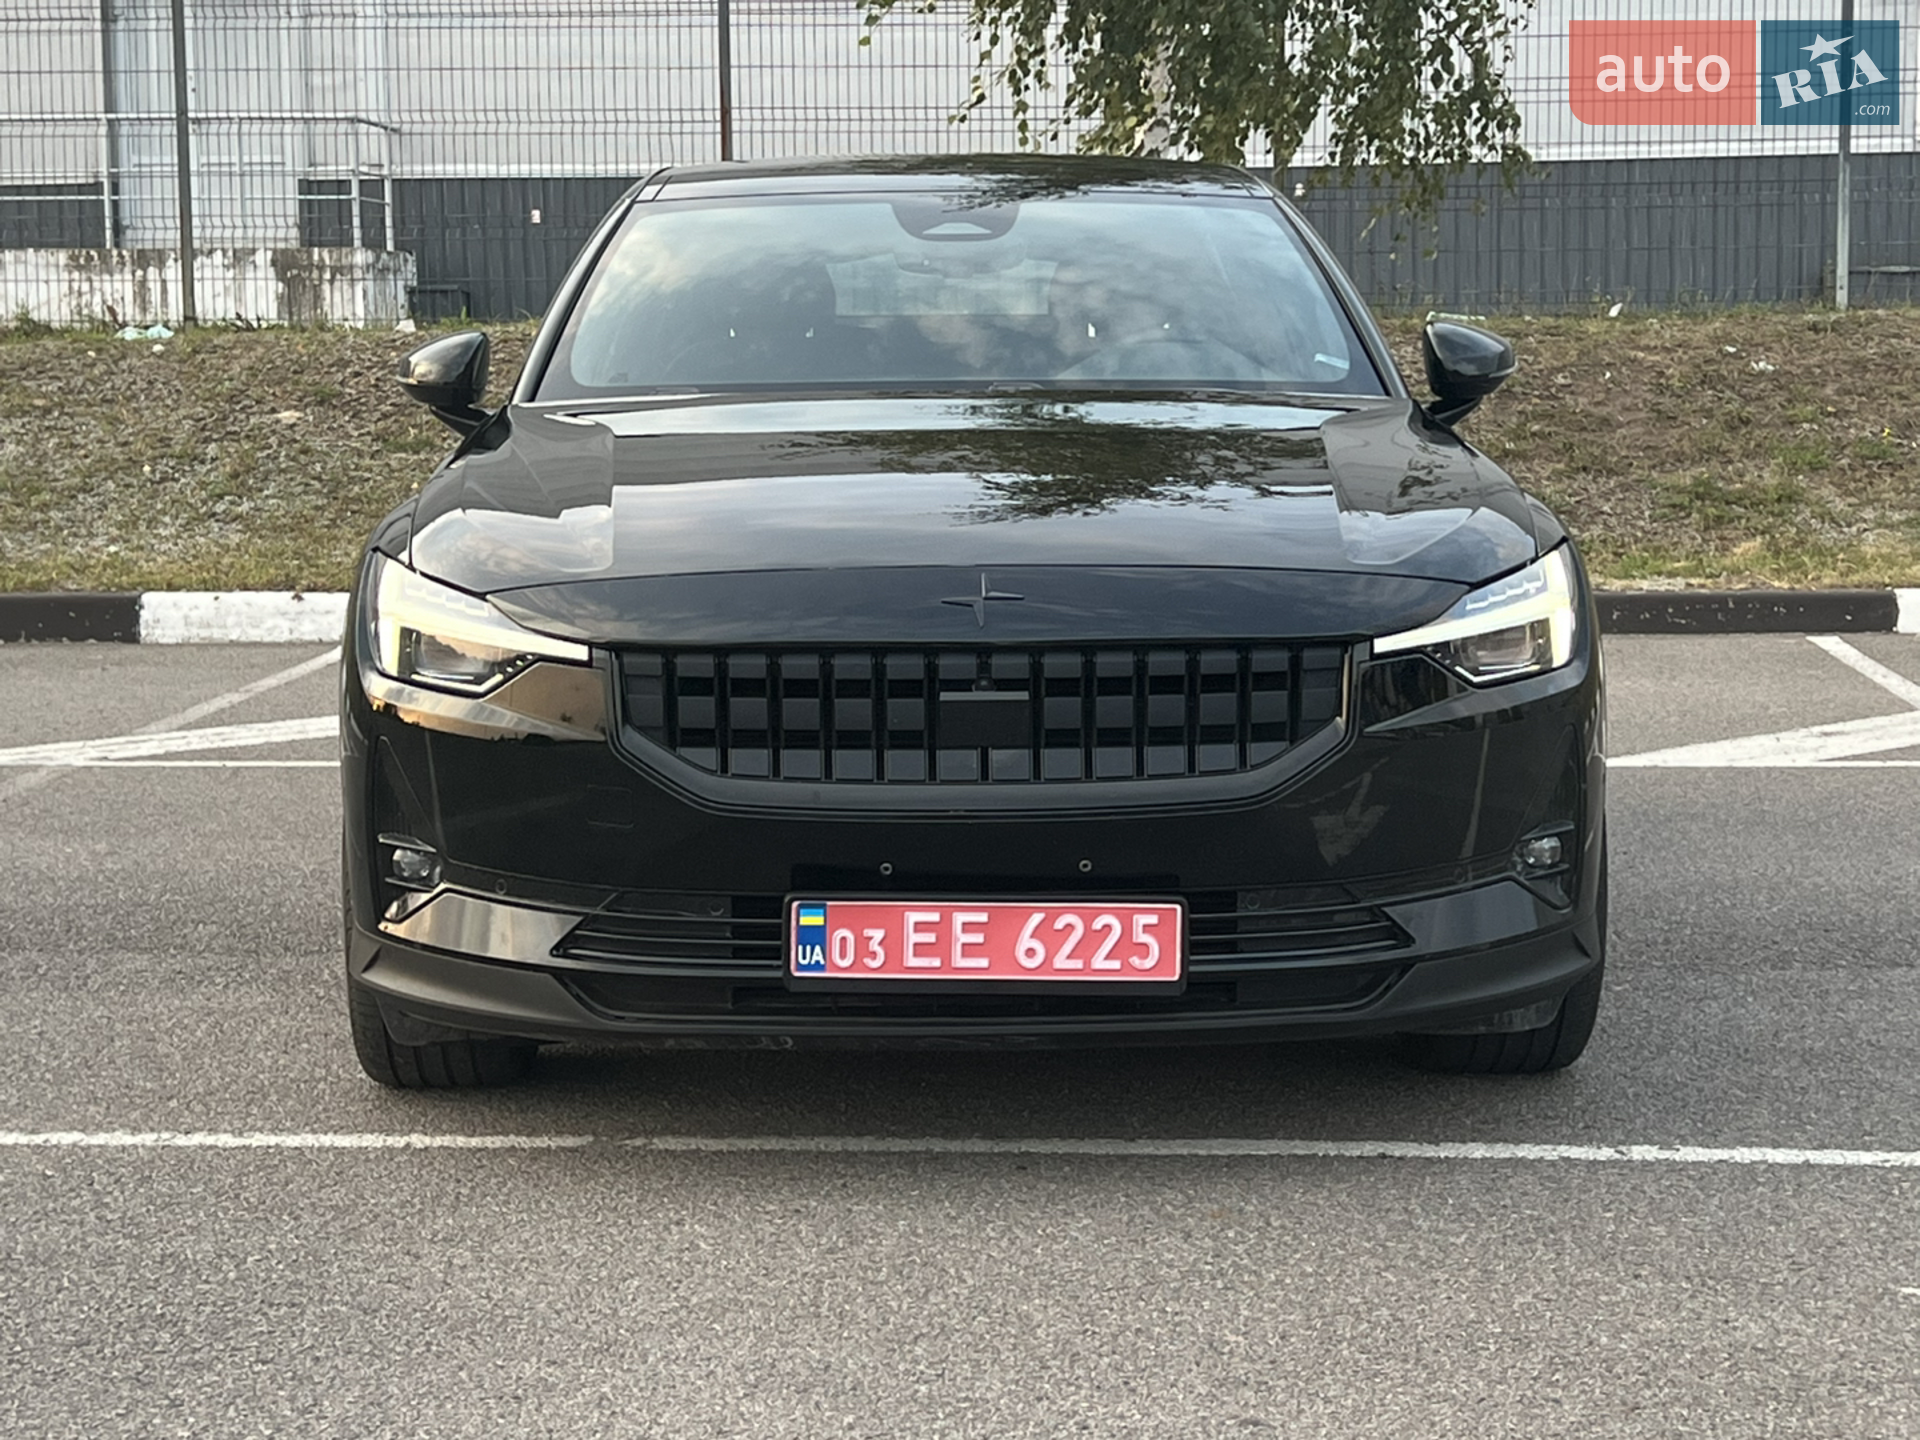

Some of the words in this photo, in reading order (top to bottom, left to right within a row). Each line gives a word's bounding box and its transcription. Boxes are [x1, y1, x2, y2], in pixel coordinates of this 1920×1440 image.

[798, 944, 825, 965] UA
[831, 927, 886, 969] 03
[903, 911, 990, 968] EE
[1014, 912, 1161, 970] 6225
